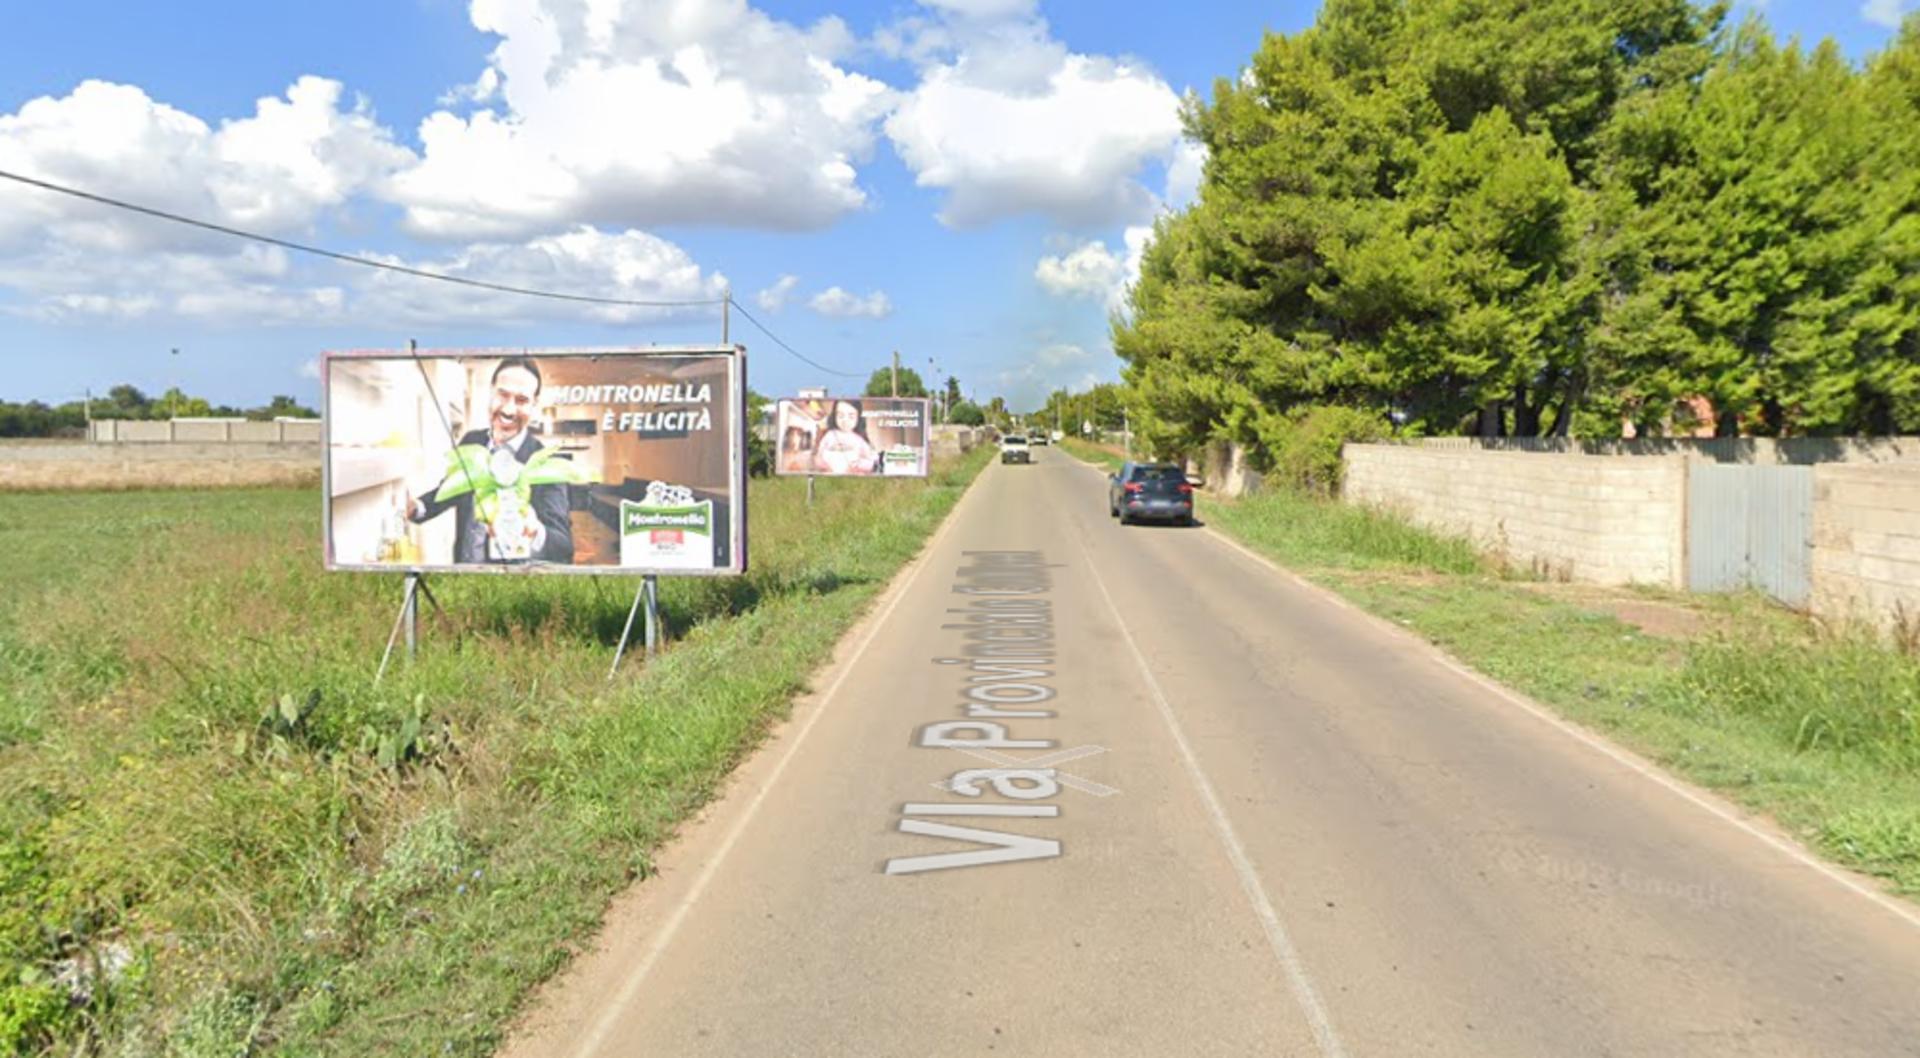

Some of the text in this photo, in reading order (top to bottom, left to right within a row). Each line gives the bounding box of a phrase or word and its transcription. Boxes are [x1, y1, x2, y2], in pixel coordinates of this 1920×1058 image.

[553, 384, 711, 403] MONTRONELLA
[602, 408, 711, 431] È FELICITÀ
[629, 512, 705, 526] Montronella
